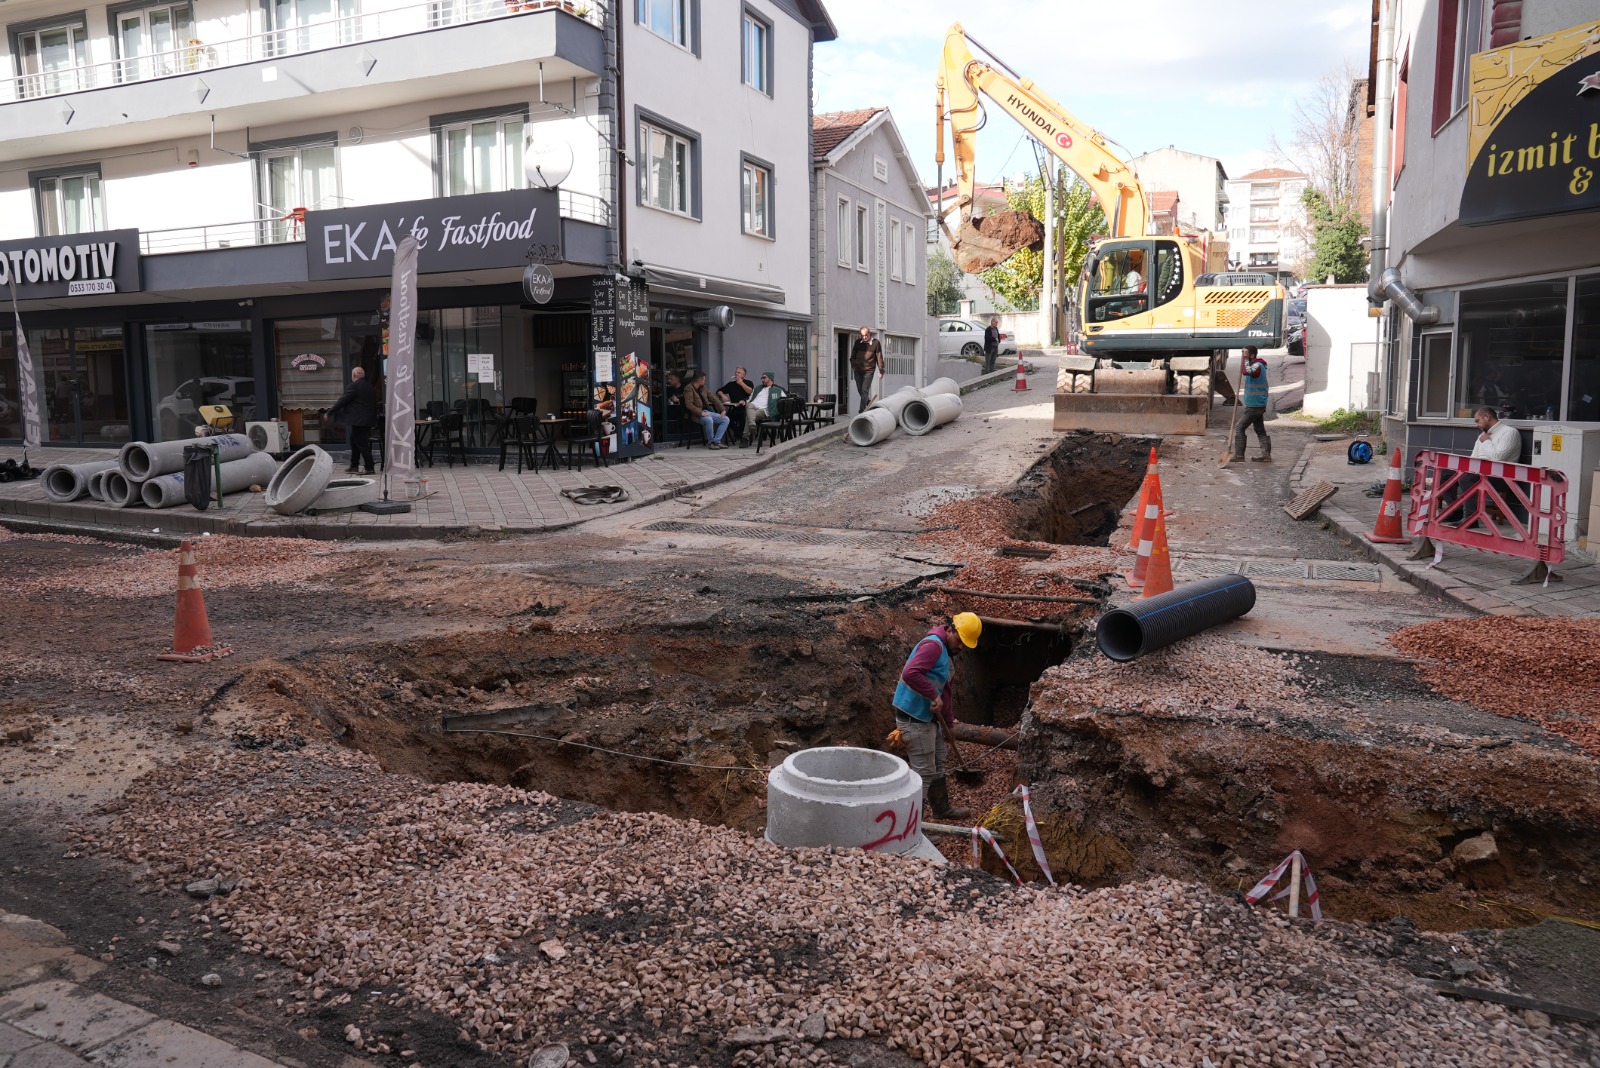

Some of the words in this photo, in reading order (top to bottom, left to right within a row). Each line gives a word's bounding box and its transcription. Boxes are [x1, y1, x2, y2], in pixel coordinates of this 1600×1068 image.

[1007, 94, 1056, 136] HYUNDAI
[1487, 131, 1577, 177] izmit
[438, 207, 537, 251] Fastfood
[70, 284, 85, 293] 0533
[86, 282, 96, 291] 170
[97, 282, 105, 291] 30
[106, 281, 113, 290] 41
